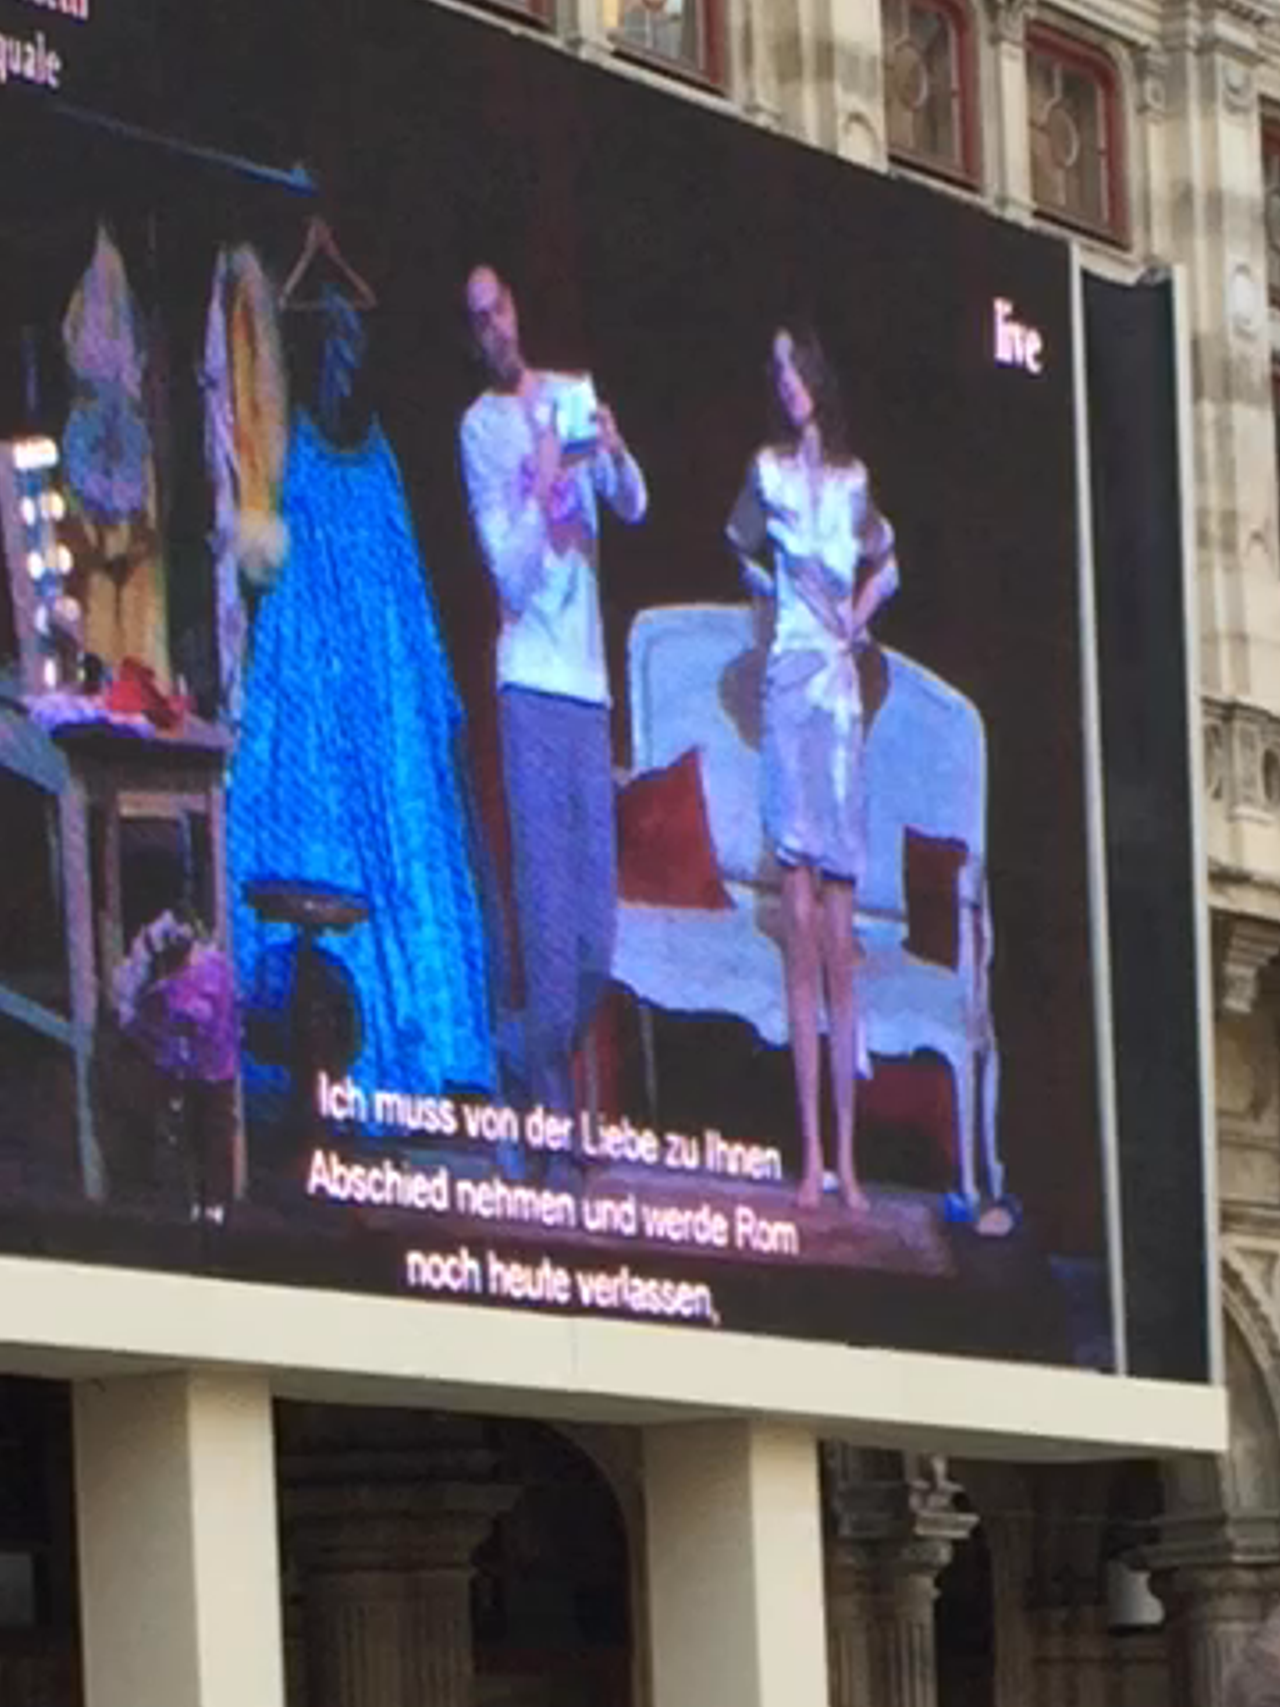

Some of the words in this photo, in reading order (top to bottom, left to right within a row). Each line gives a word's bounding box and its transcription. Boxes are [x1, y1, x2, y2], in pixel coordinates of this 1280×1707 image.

[993, 296, 1042, 373] live
[318, 1071, 366, 1122] Ich
[375, 1091, 458, 1134] muss
[463, 1104, 519, 1141] von
[524, 1105, 573, 1151] der
[581, 1111, 658, 1164] Liebe
[665, 1132, 699, 1168] zu
[705, 1129, 782, 1180] Ihnen
[307, 1149, 449, 1210] Abschied
[456, 1177, 576, 1228] nehmen
[583, 1194, 637, 1236] und
[642, 1204, 728, 1247] werde
[736, 1205, 798, 1255] Rom
[406, 1247, 481, 1292] noch
[487, 1250, 570, 1304] heute
